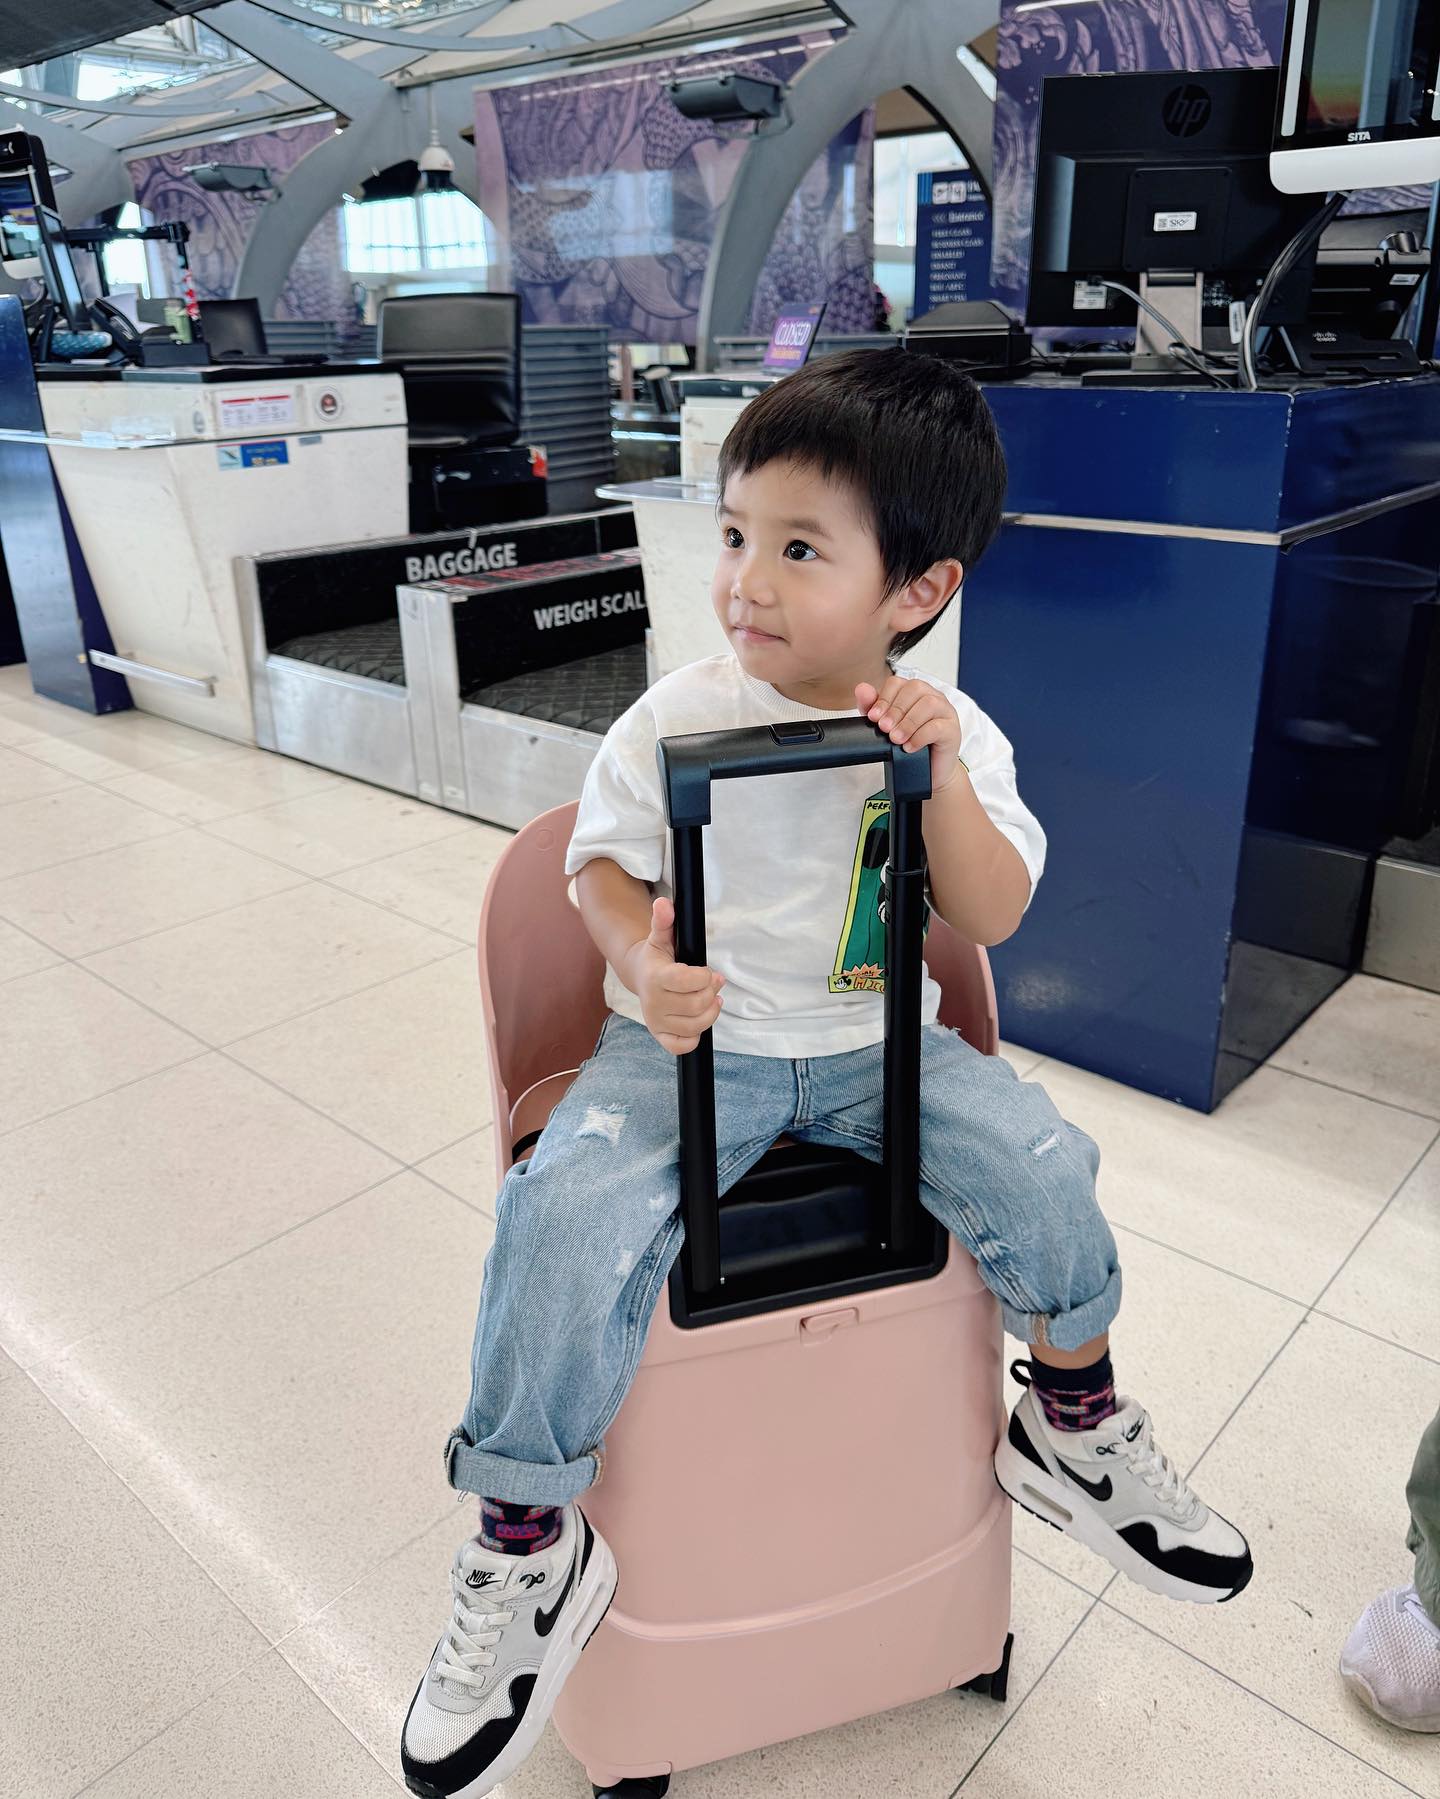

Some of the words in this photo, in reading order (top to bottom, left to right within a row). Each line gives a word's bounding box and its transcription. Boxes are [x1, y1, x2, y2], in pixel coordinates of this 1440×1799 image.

[1167, 86, 1209, 138] hp
[1347, 131, 1371, 142] SITA
[405, 543, 518, 582] BAGGAGE
[533, 598, 598, 630] WEIGH
[600, 590, 646, 617] SCAL
[866, 801, 891, 811] PERF
[469, 1569, 496, 1584] NIKE
